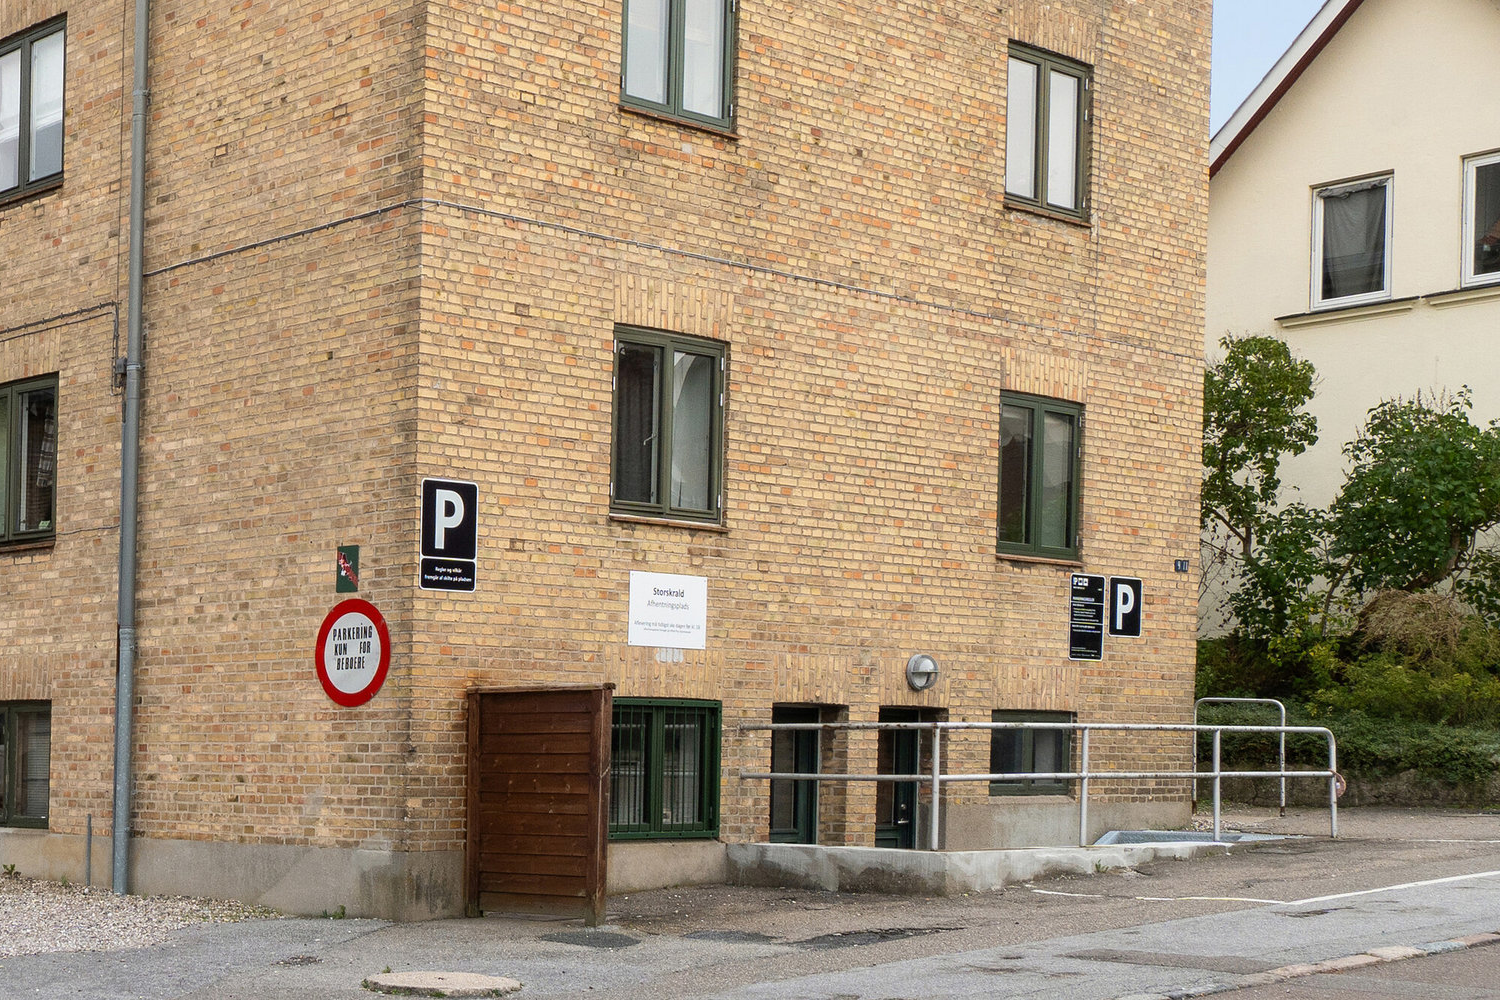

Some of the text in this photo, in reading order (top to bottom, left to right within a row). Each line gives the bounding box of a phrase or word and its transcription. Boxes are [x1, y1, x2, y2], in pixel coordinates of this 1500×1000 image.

[435, 489, 464, 549] P
[653, 587, 685, 598] Storskrald
[1116, 583, 1134, 630] P
[334, 641, 371, 656] KUN FOR
[337, 656, 365, 670] BEBOERE
